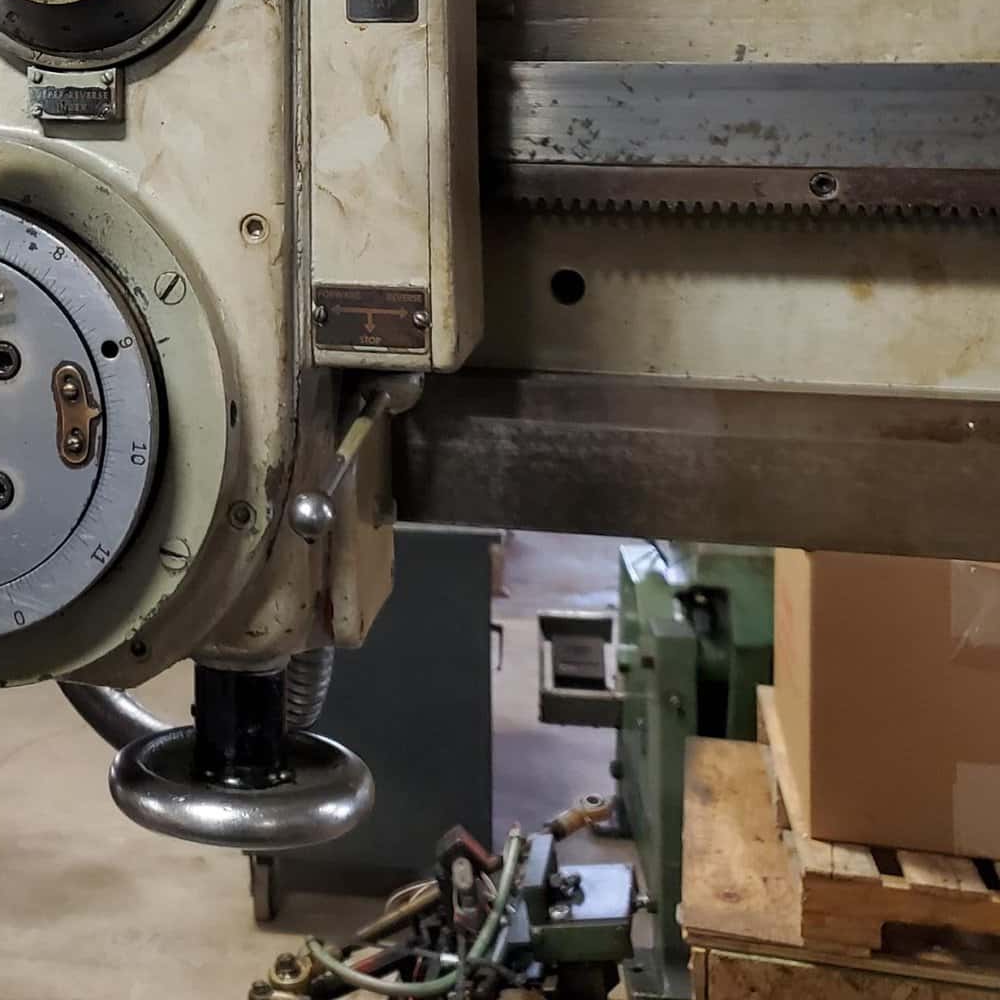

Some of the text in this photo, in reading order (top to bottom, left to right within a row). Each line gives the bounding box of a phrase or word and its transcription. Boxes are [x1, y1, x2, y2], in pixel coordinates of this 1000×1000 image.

[52, 246, 65, 261] 8
[131, 440, 147, 466] 10
[90, 543, 111, 565] 11
[13, 610, 26, 626] 0
